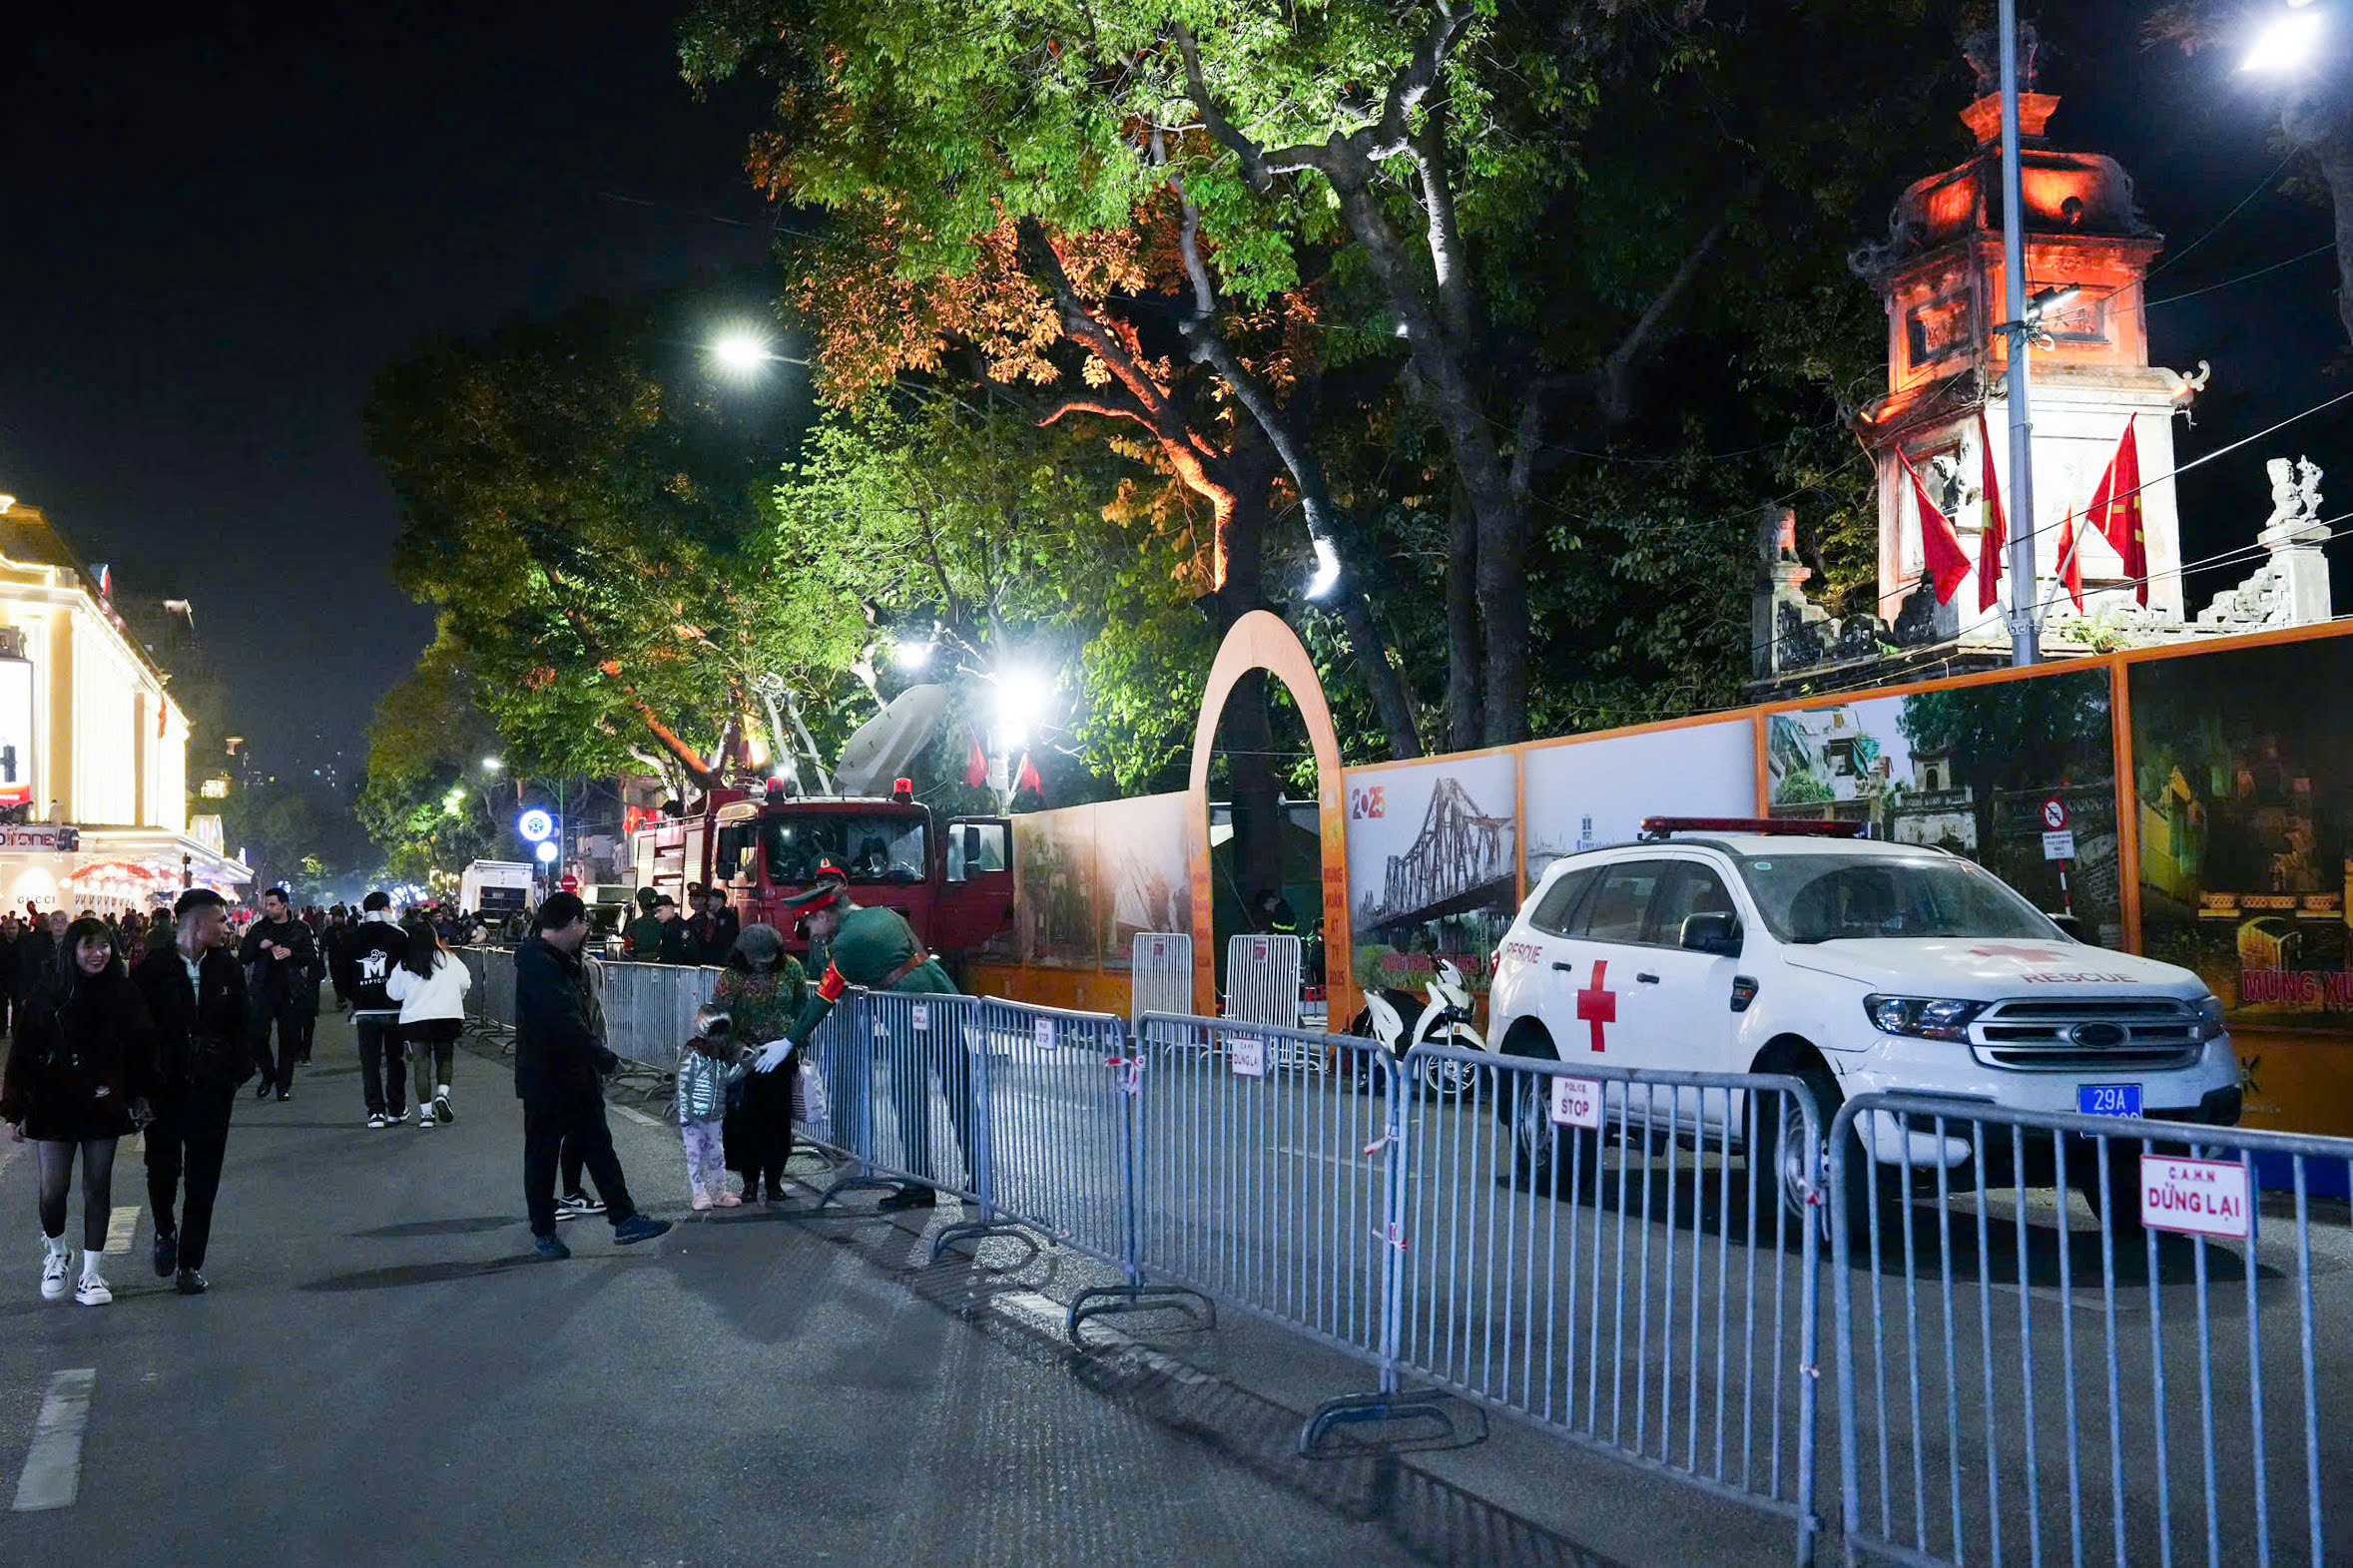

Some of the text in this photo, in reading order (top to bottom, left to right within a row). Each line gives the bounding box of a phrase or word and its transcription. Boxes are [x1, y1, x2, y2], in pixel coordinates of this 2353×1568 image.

[1352, 786, 1386, 819] 2025
[1507, 942, 1542, 963] RESCUE
[2019, 972, 2139, 983] RESCUE
[1564, 1082, 1586, 1094] POLICE
[1561, 1098, 1589, 1117] STOP
[2093, 1089, 2125, 1110] 29A
[2148, 1182, 2239, 1222] DỪNG LẠI
